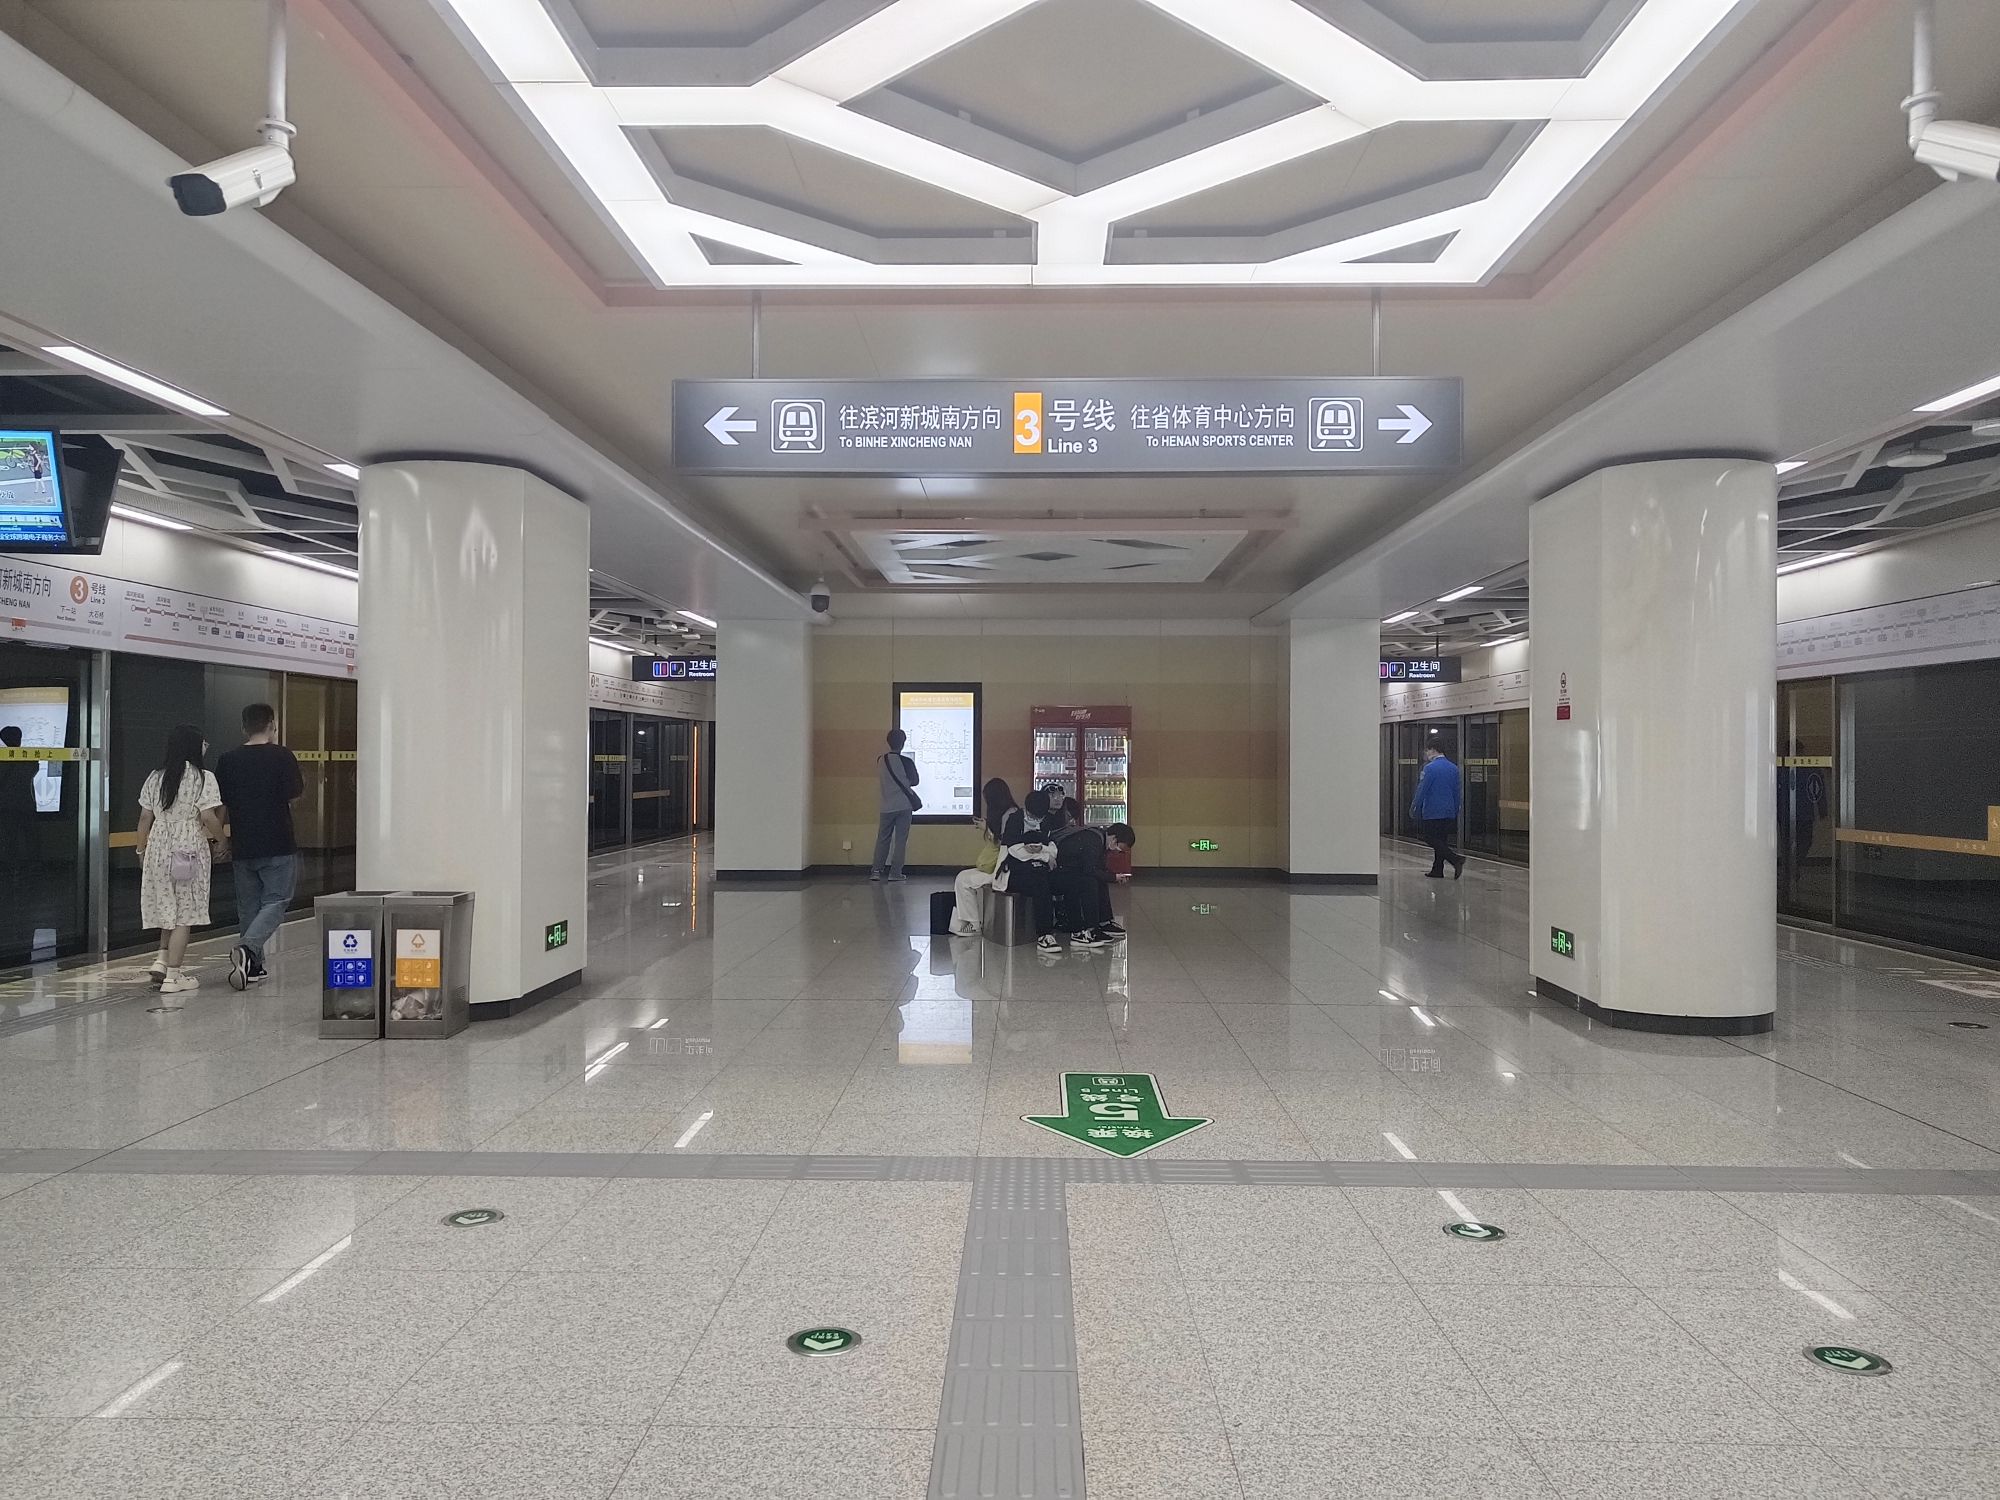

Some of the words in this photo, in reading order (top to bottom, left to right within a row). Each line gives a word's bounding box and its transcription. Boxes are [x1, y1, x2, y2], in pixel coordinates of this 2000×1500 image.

[839, 404, 1001, 430] 往滨河新城南方向
[1016, 409, 1040, 446] 3
[1048, 398, 1116, 432] 号线
[1130, 403, 1295, 429] 往省体育中心方向
[839, 436, 853, 448] To
[855, 436, 888, 448] BINHE
[891, 436, 946, 448] XINCHENG
[949, 436, 972, 448] NAN
[1048, 438, 1083, 453] Line
[1087, 438, 1098, 453] 3
[1146, 434, 1159, 447] To
[1161, 434, 1200, 447] HENAN
[1202, 434, 1246, 446] SPORTS
[1249, 434, 1294, 446] CENTER
[0, 567, 51, 597] 新城南方向
[74, 579, 85, 600] 3
[91, 582, 106, 596] 号线
[688, 659, 716, 671] 卫生间
[1409, 660, 1440, 672] 卫生间
[1089, 1102, 1139, 1121] 5
[1087, 1128, 1153, 1138] 换乘
